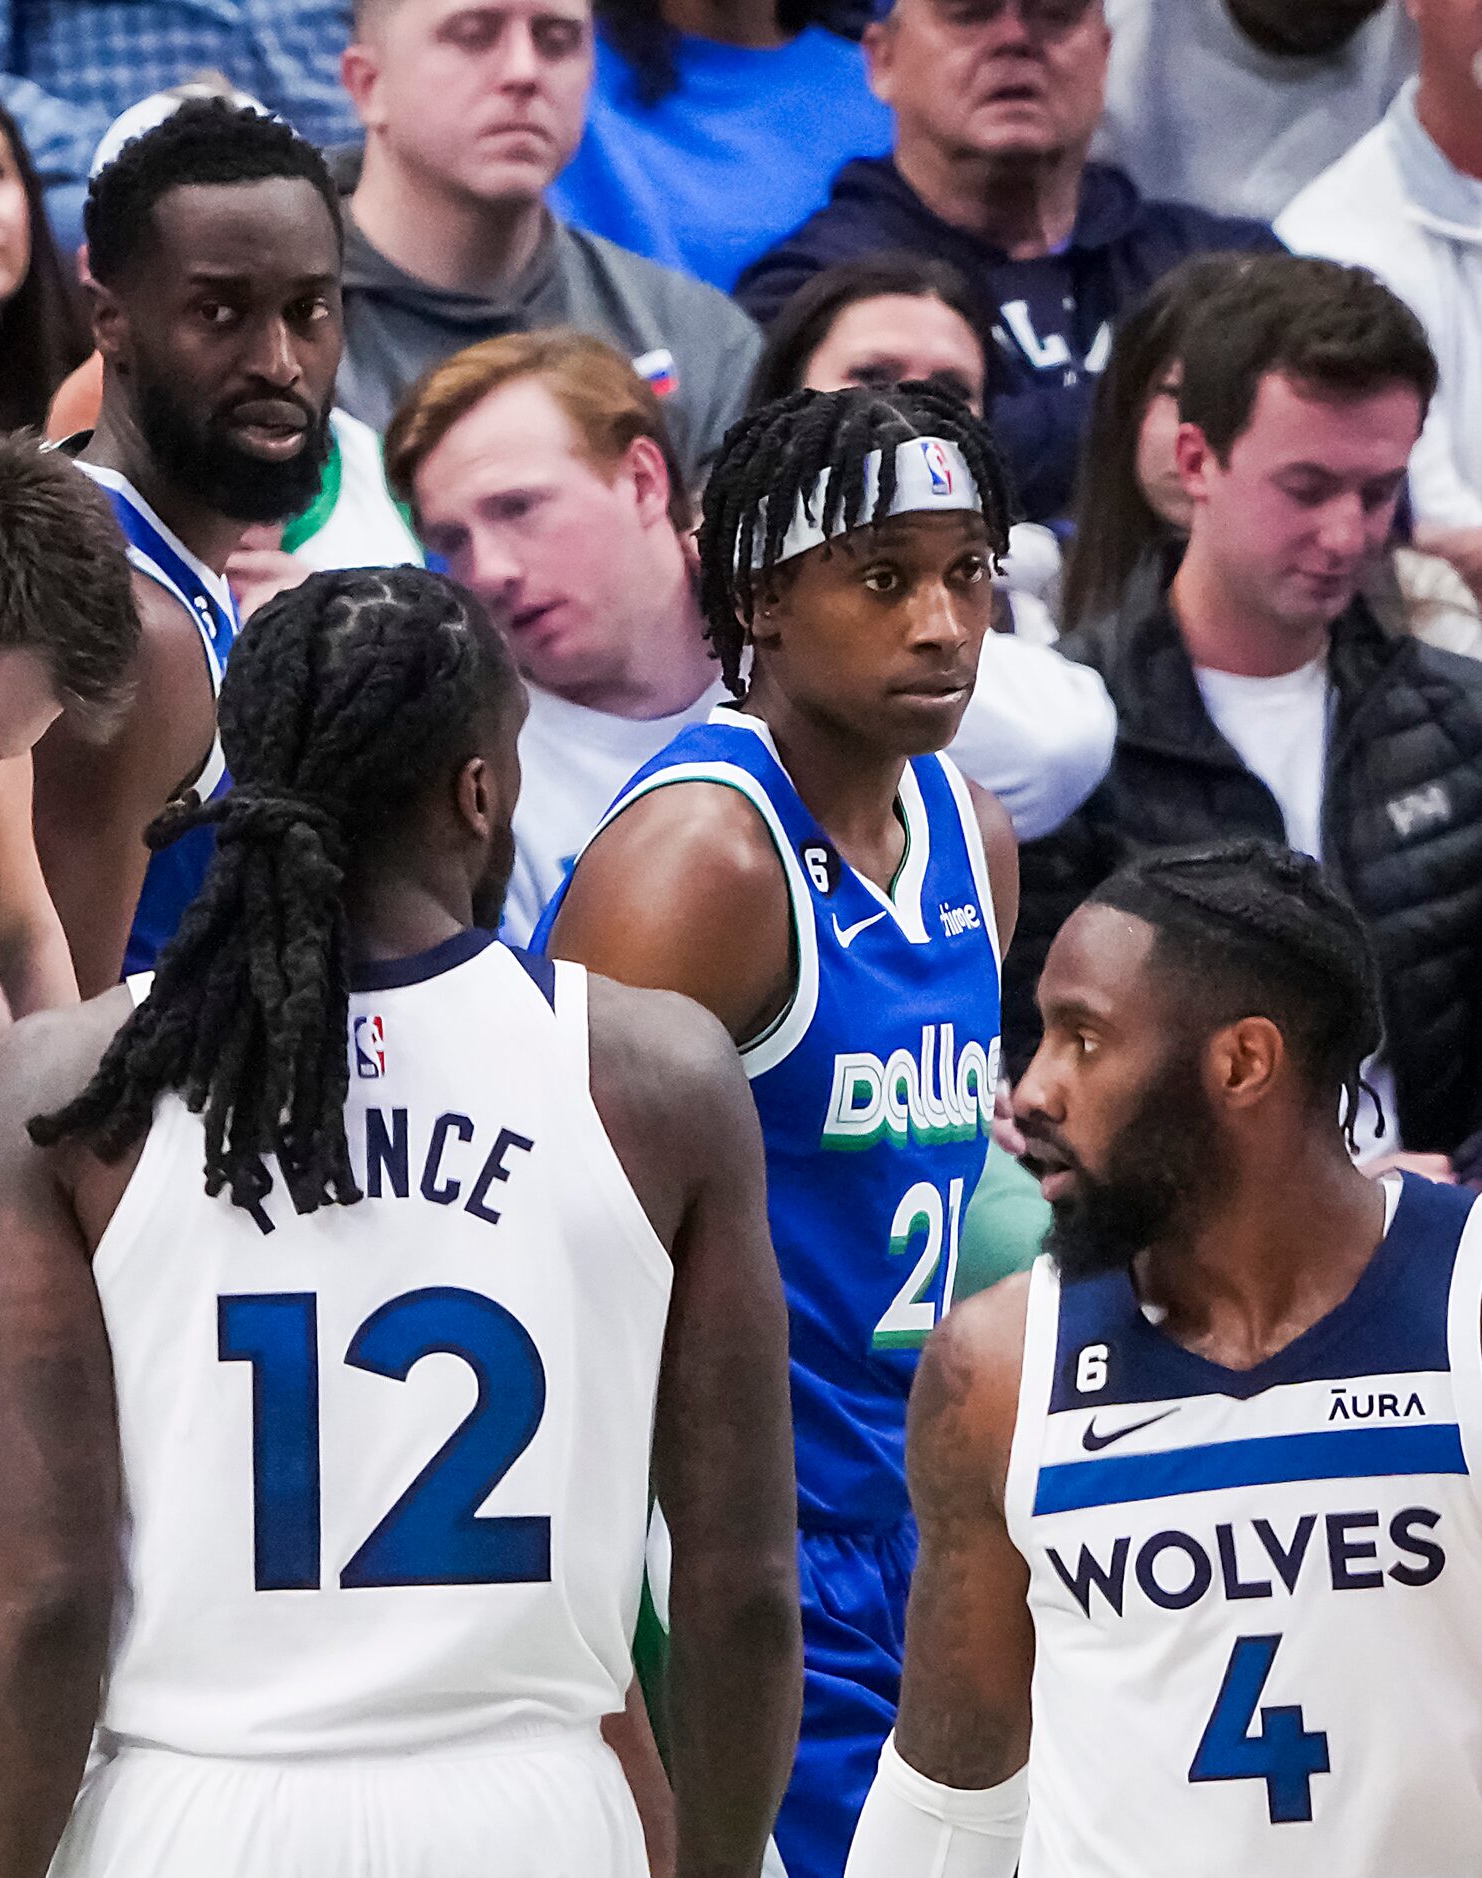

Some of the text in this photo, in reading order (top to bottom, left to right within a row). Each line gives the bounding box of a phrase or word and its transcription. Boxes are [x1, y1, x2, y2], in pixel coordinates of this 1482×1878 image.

[804, 848, 830, 893] 6
[1076, 1343, 1108, 1393] 6
[217, 1286, 552, 1592] 12
[1045, 1506, 1446, 1620] WOLVES
[1188, 1632, 1331, 1824] 4
